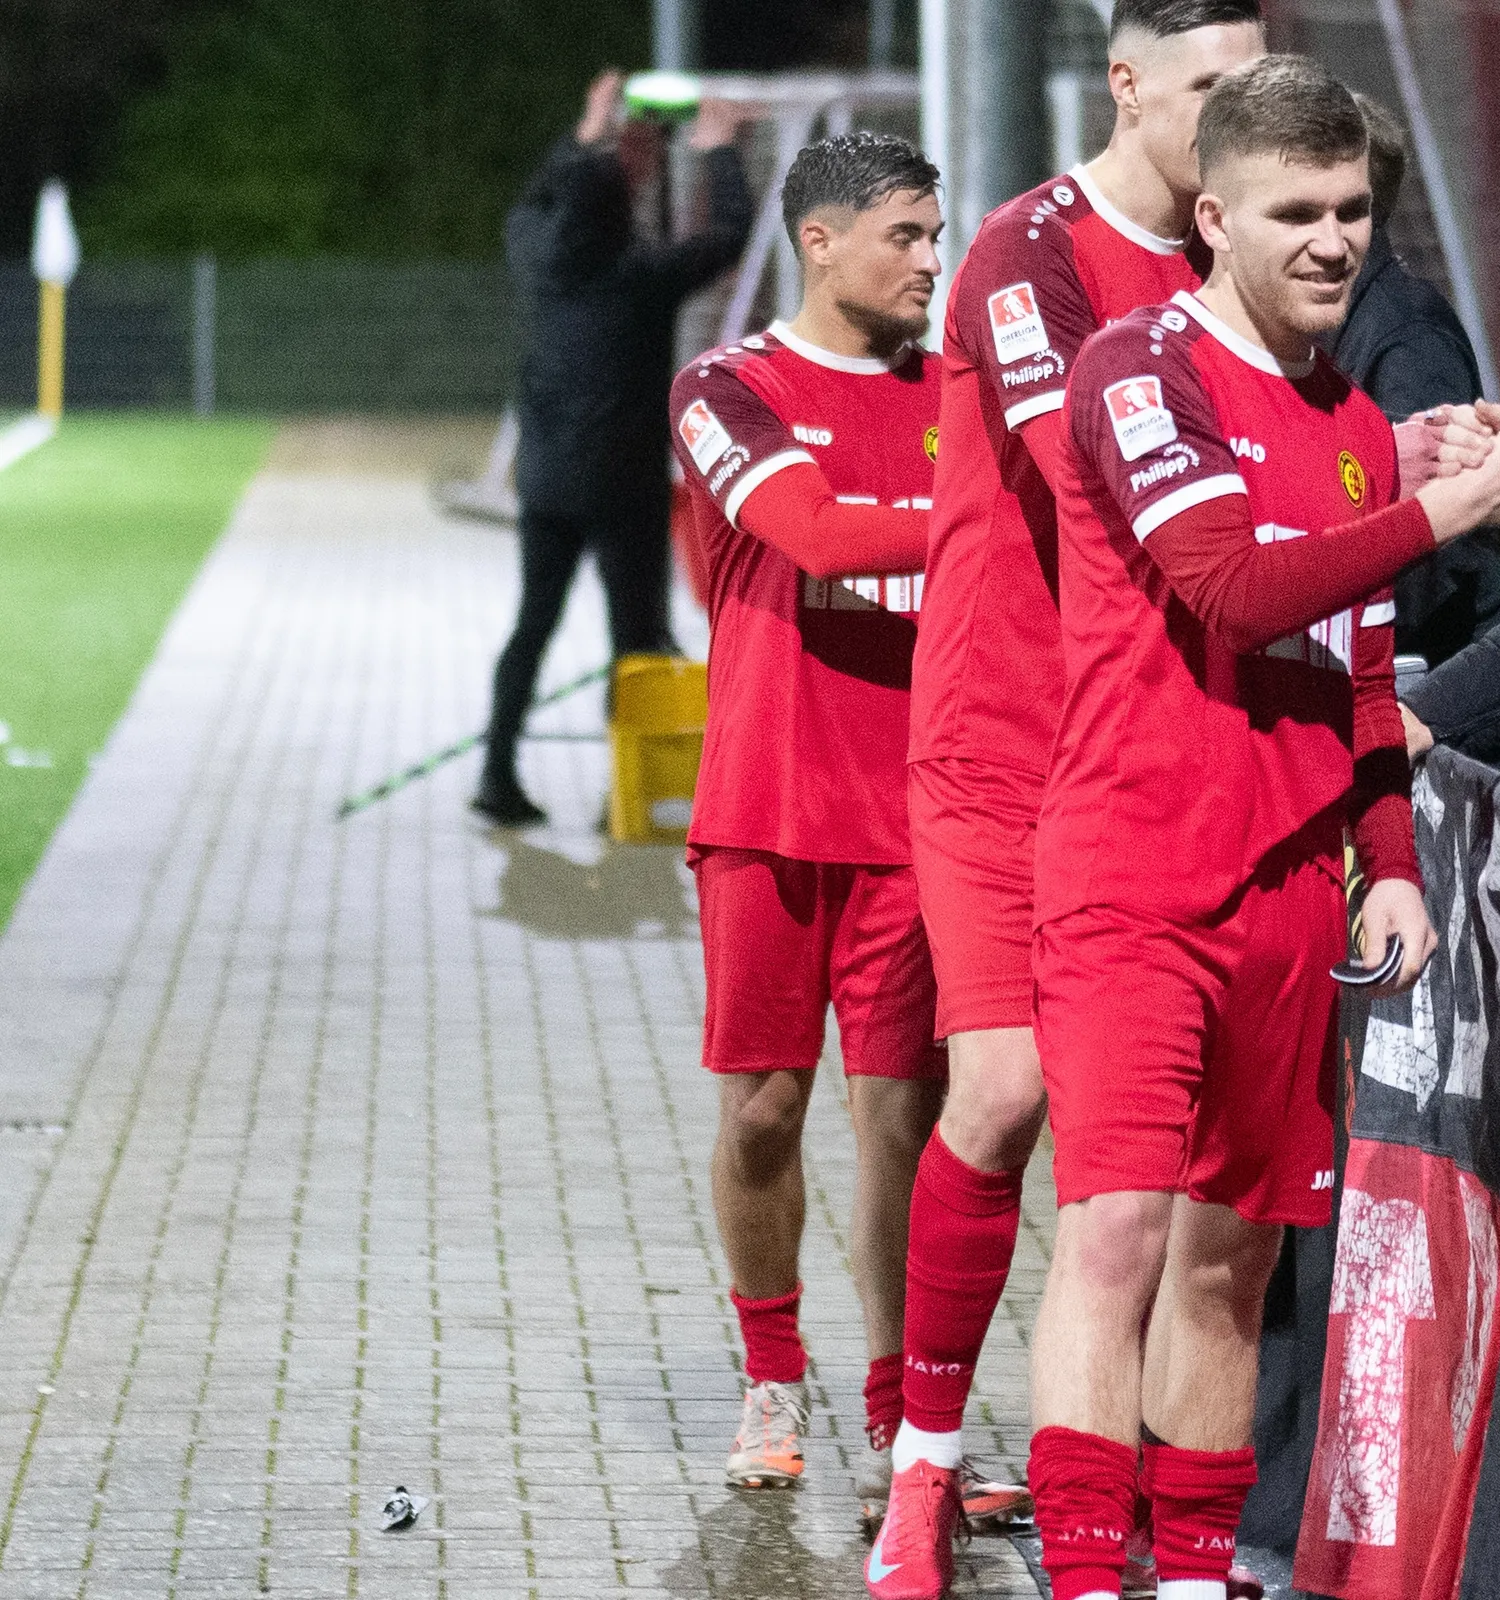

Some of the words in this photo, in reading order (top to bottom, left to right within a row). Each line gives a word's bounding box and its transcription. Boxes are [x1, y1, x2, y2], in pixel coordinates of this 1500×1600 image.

[1001, 363, 1054, 389] Philipp
[709, 457, 742, 497] Philipp
[1130, 455, 1189, 493] Philipp
[1311, 1170, 1334, 1190] JA
[905, 1356, 960, 1376] JAKO
